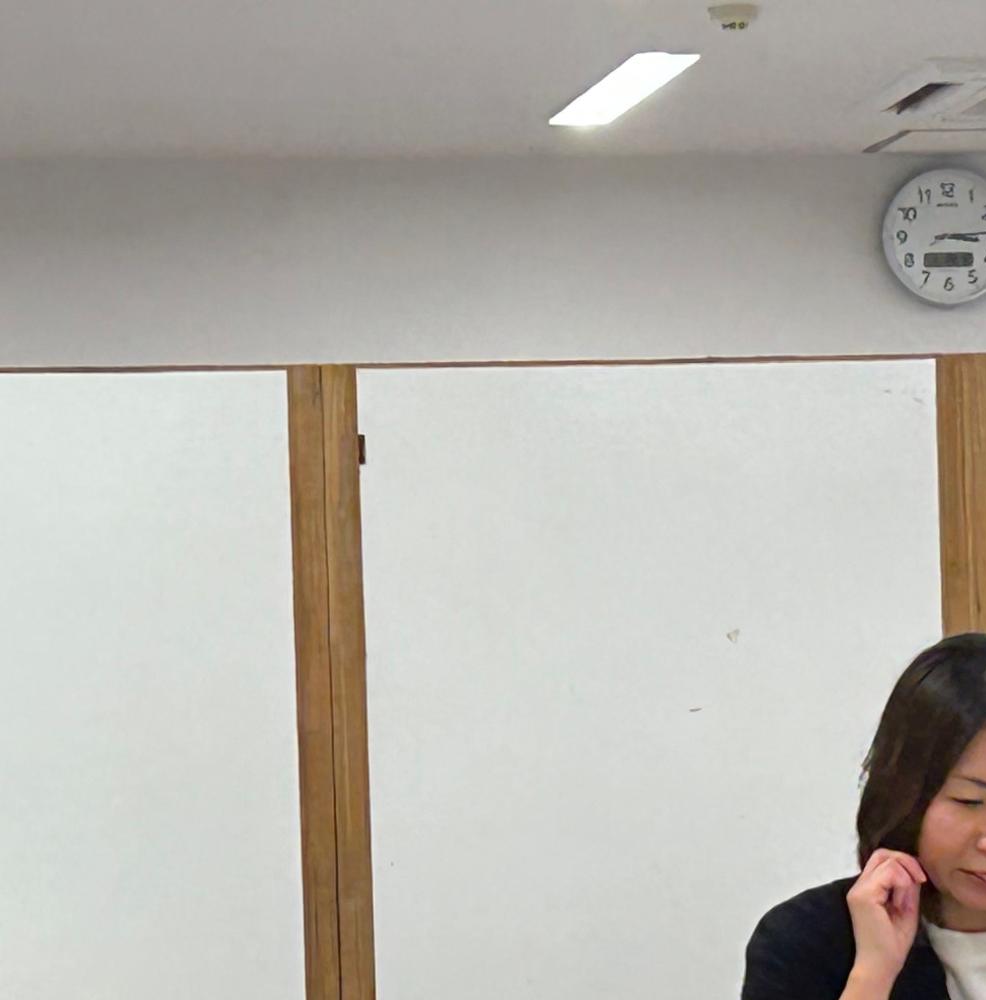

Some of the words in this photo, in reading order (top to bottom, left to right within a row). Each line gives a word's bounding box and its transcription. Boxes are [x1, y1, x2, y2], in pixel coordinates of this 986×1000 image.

[968, 189, 975, 203] 1
[896, 229, 908, 244] 9
[904, 252, 916, 268] 8
[921, 270, 931, 286] 7
[943, 276, 955, 292] 6
[967, 269, 978, 284] 5
